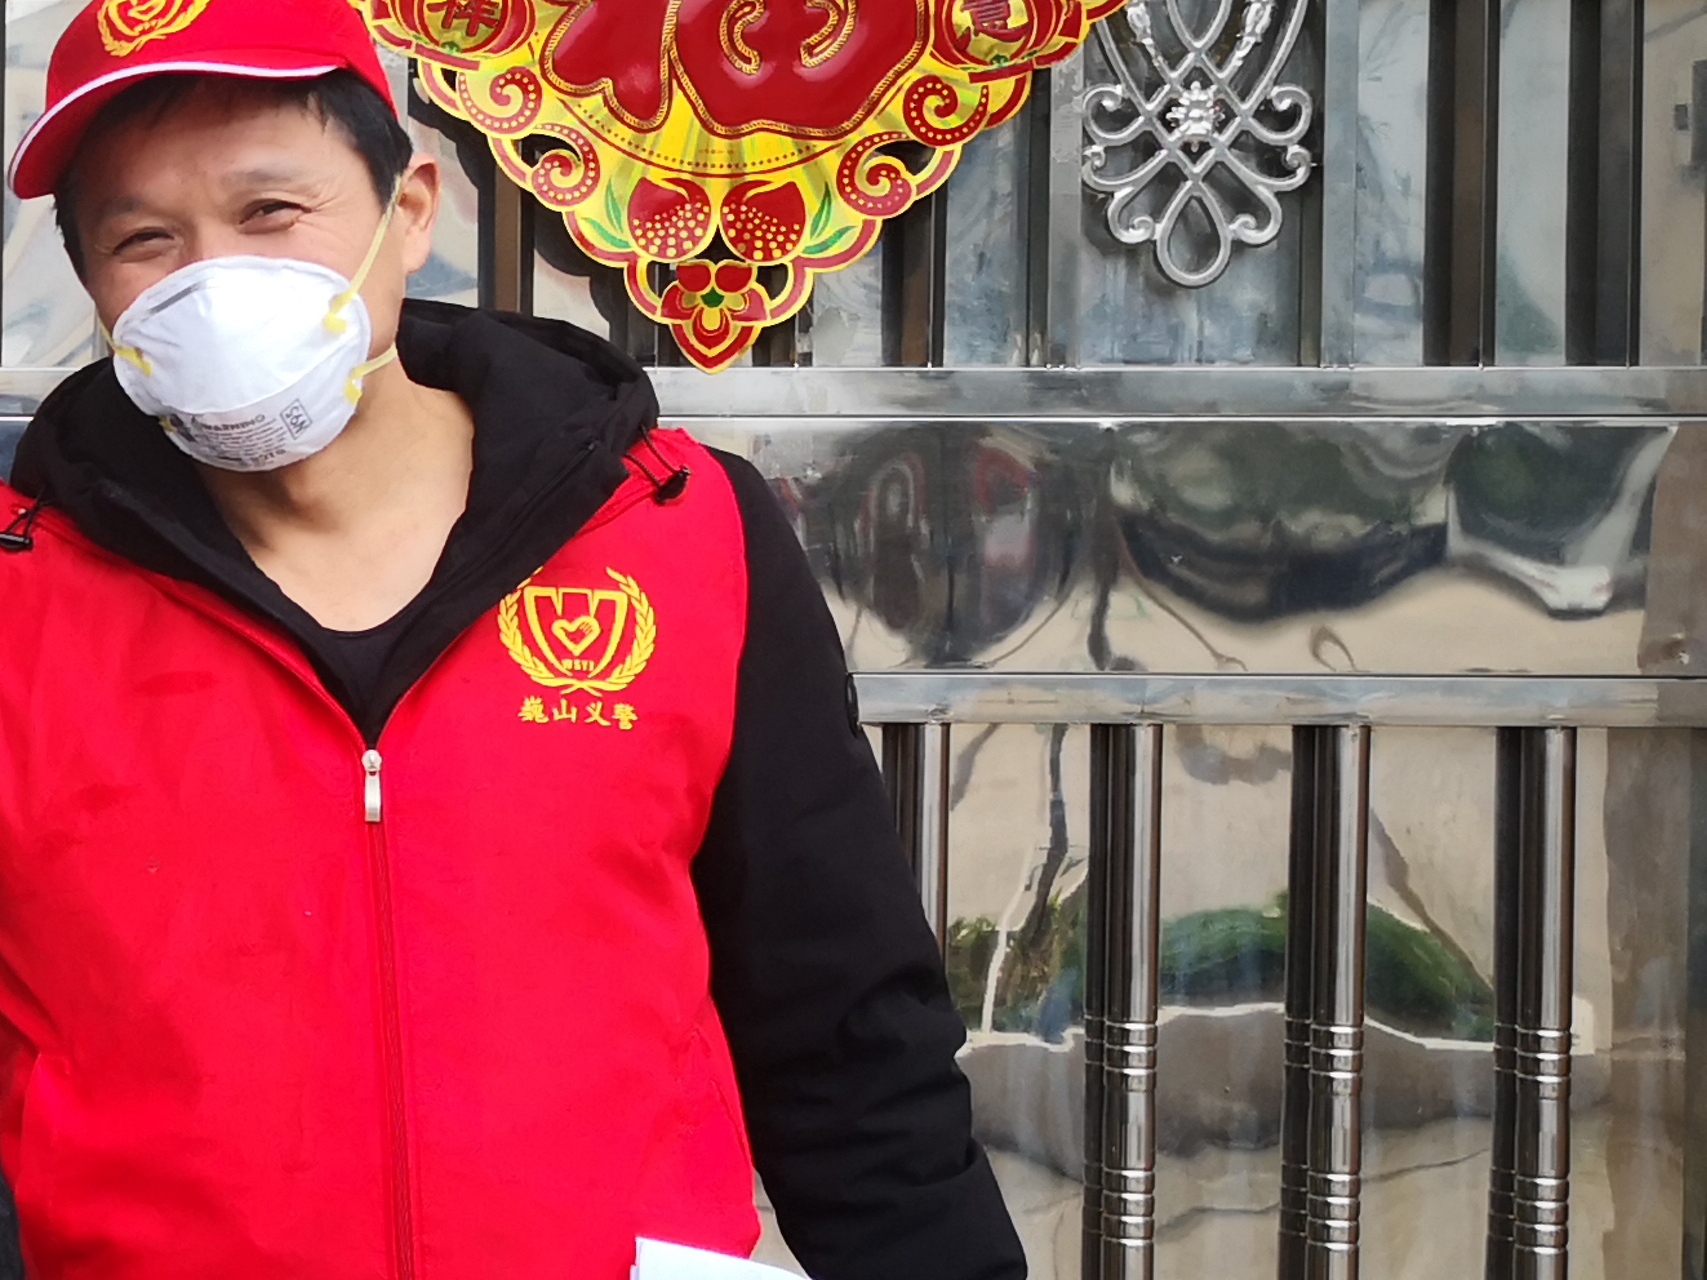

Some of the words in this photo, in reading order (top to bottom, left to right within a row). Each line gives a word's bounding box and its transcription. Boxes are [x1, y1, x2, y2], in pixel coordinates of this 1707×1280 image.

[284, 405, 307, 434] N95
[518, 695, 638, 730] 巍山义警
